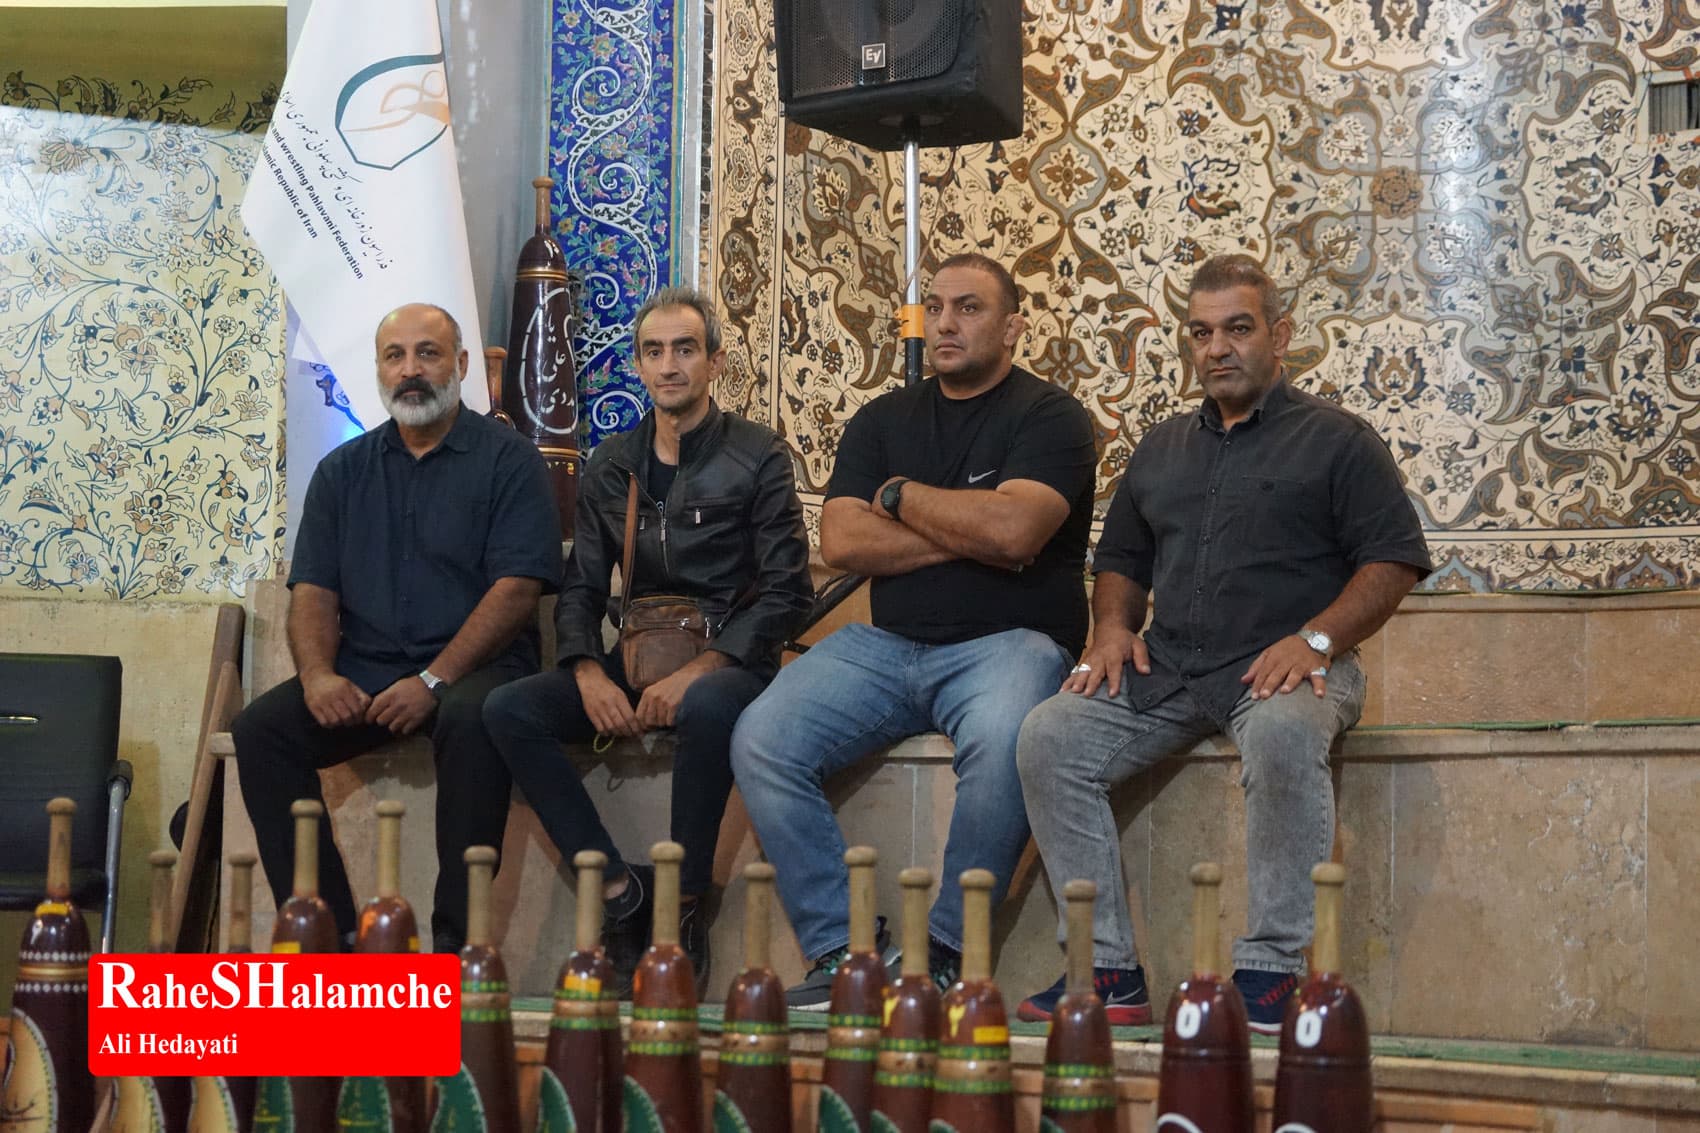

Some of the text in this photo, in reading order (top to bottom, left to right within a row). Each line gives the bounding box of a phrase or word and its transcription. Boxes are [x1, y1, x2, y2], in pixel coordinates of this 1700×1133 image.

[271, 128, 364, 280] and wrestling Pahlavani Federation
[273, 168, 300, 208] Republic
[296, 208, 308, 220] of
[302, 218, 318, 239] Iran
[542, 350, 567, 382] علی
